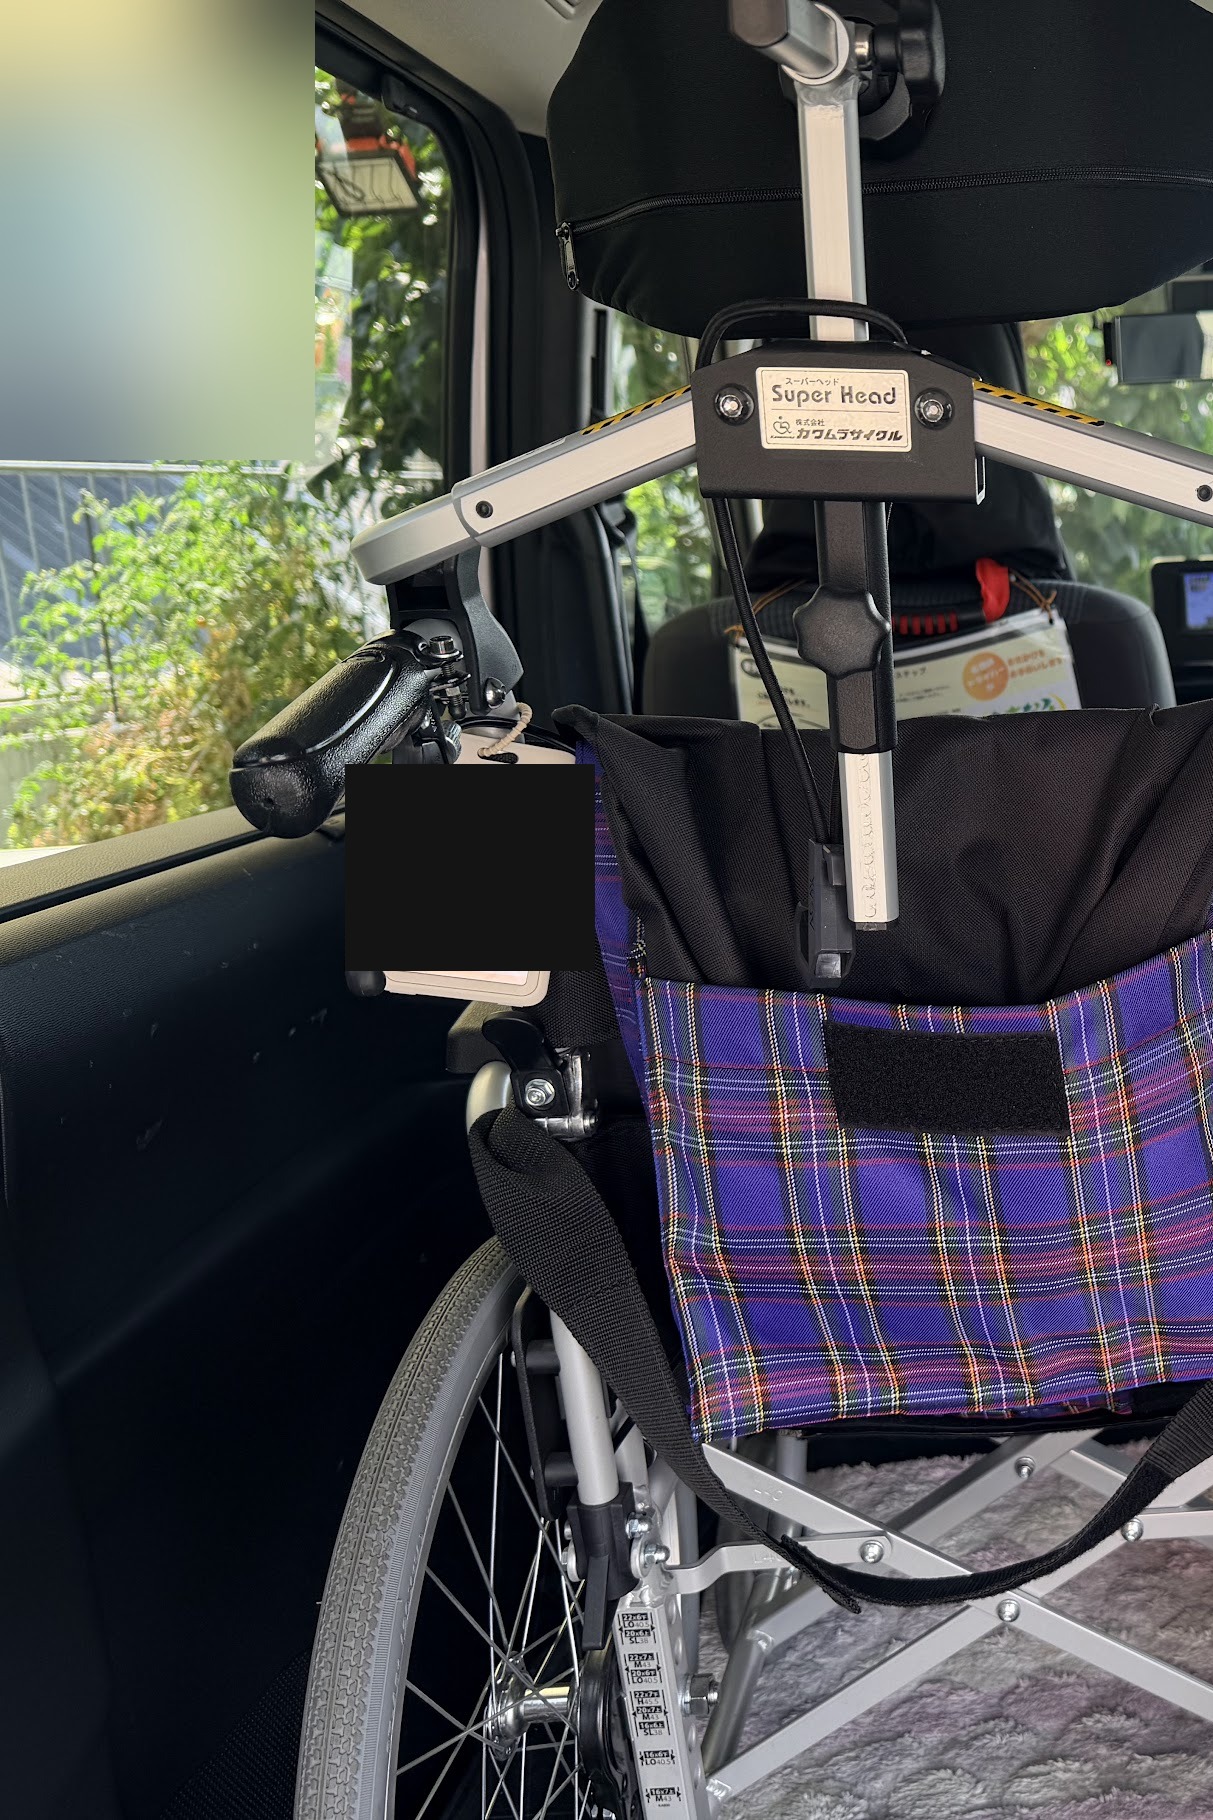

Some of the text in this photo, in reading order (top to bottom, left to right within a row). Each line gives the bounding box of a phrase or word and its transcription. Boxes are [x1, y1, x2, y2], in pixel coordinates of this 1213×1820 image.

[785, 377, 839, 386] スーパーヘッド
[771, 384, 896, 407] Super Head
[795, 418, 825, 427] 株式会社
[796, 428, 903, 441] カワムラサイクル
